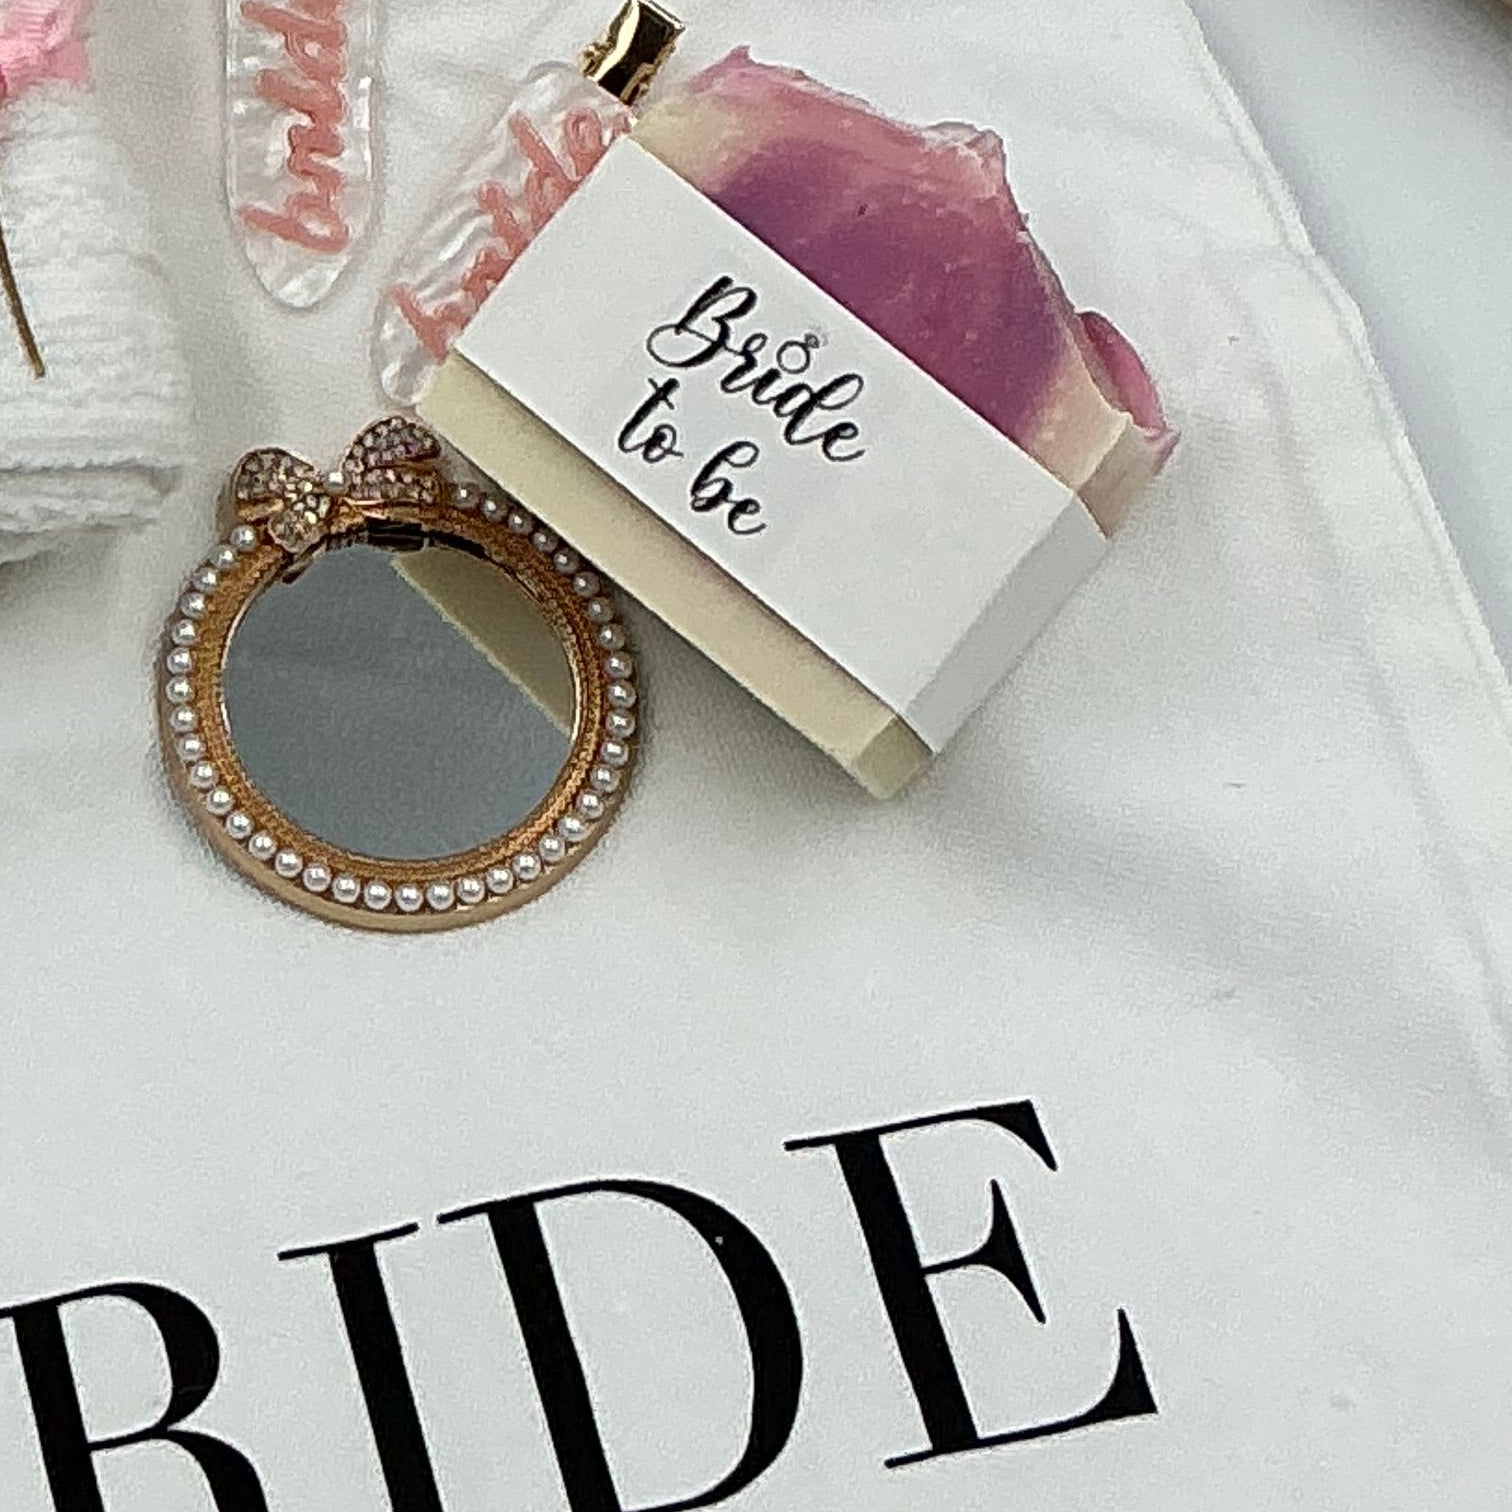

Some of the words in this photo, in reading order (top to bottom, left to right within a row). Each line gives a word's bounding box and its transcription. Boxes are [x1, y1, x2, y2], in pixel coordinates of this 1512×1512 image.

[617, 376, 684, 465] to
[689, 440, 767, 536] be
[645, 275, 867, 463] Bride
